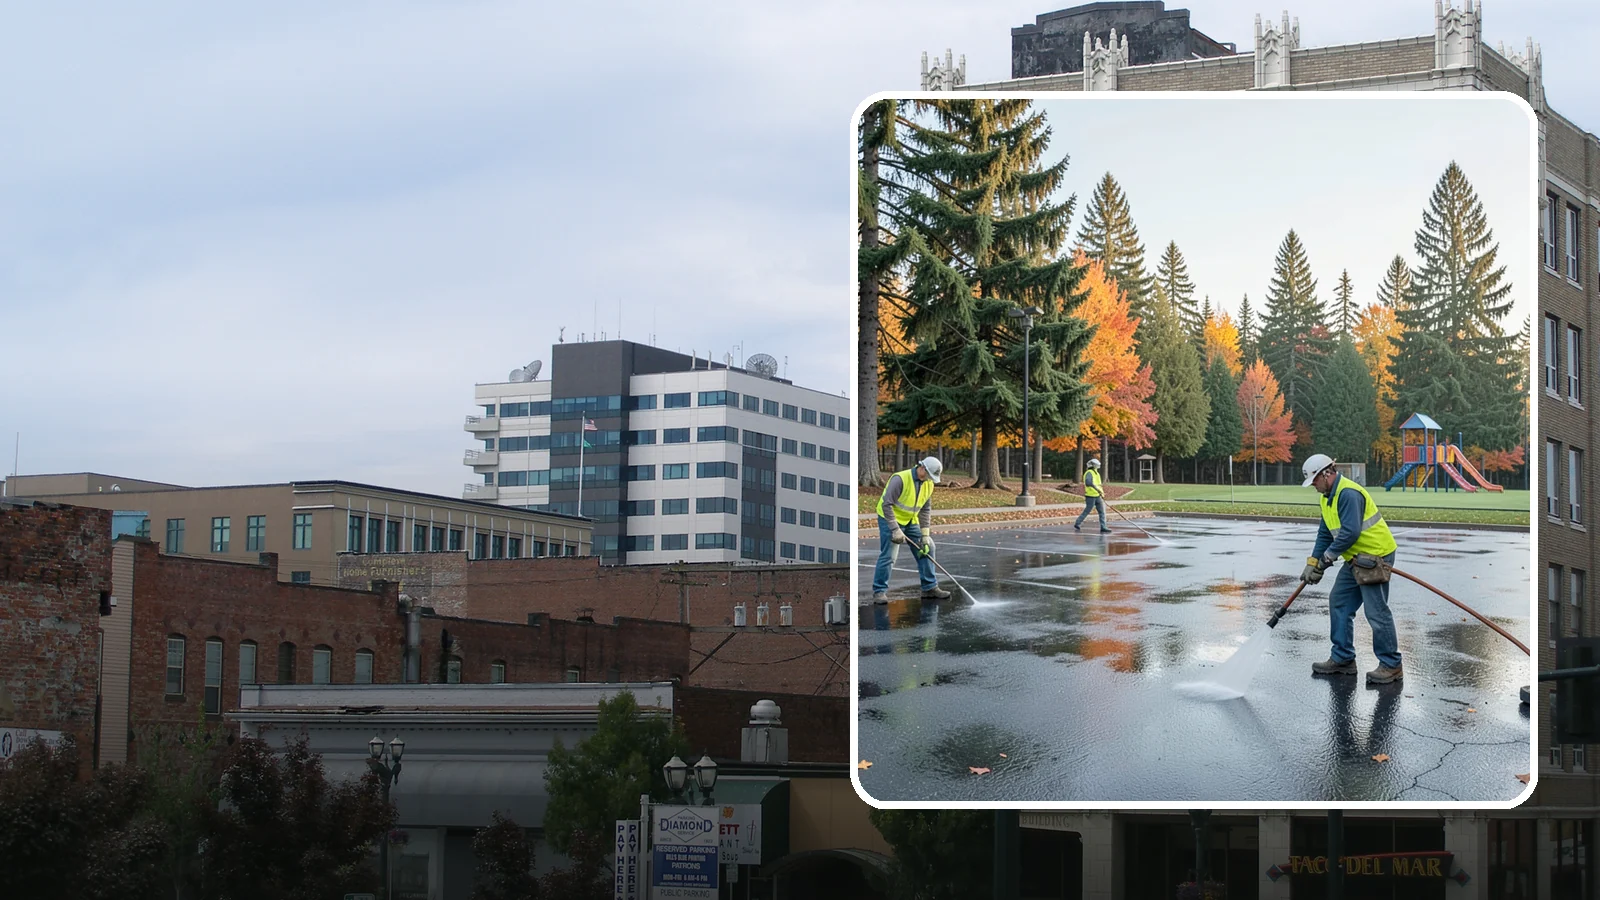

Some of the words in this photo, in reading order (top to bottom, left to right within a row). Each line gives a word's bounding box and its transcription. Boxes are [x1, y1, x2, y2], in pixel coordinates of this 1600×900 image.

[343, 567, 368, 577] Home
[370, 566, 427, 577] Furnishers
[660, 818, 713, 833] DIAMOND
[1021, 815, 1070, 828] BUILDING
[617, 825, 625, 852] PAY
[628, 824, 637, 852] PAY
[656, 845, 688, 853] RESERVED
[689, 846, 716, 854] PARKING
[721, 851, 739, 863] Soup
[671, 862, 701, 870] PATRONS
[1346, 856, 1385, 876] DEL
[1392, 857, 1443, 877] MAR
[616, 856, 625, 893] HERE
[627, 855, 636, 893] HERE
[660, 888, 682, 897] PUBLIC
[683, 889, 711, 898] PARKING
